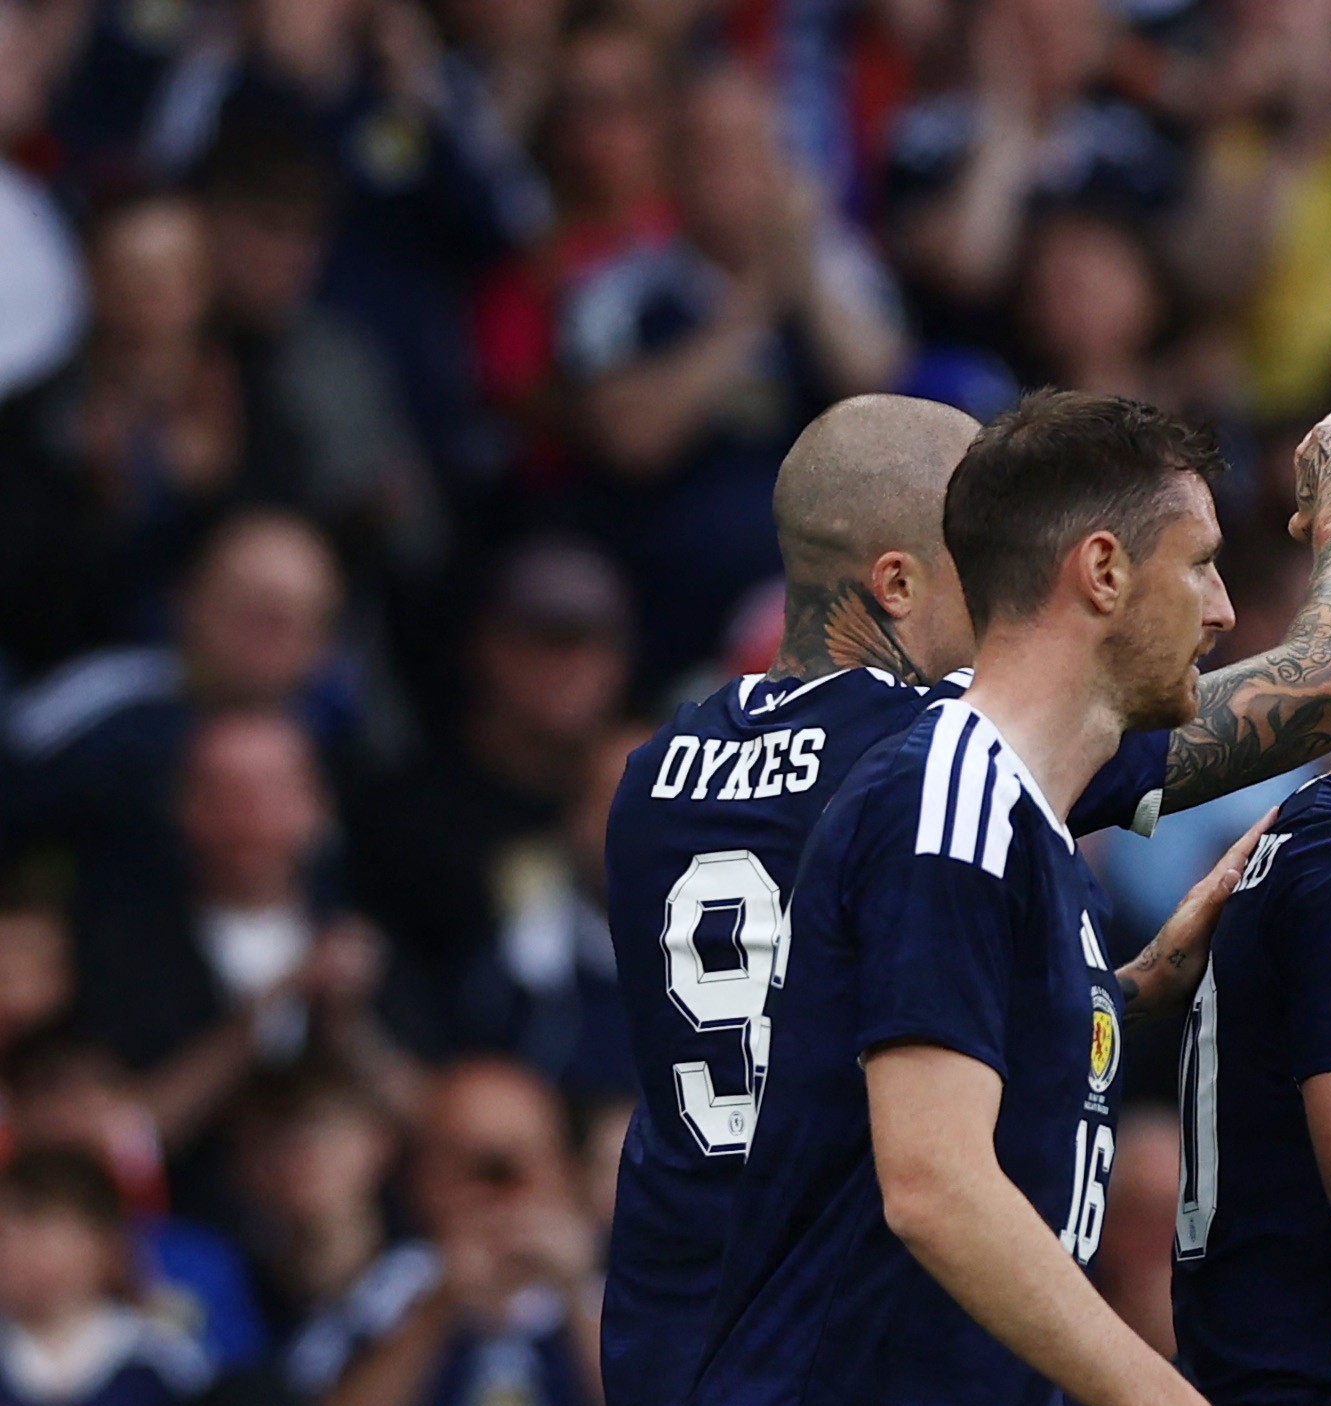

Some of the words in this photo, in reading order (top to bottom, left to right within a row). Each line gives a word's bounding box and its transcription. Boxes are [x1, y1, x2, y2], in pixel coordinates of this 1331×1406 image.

[651, 727, 826, 800] DYKES
[660, 849, 791, 1164] 9
[1060, 1119, 1115, 1266] 16
